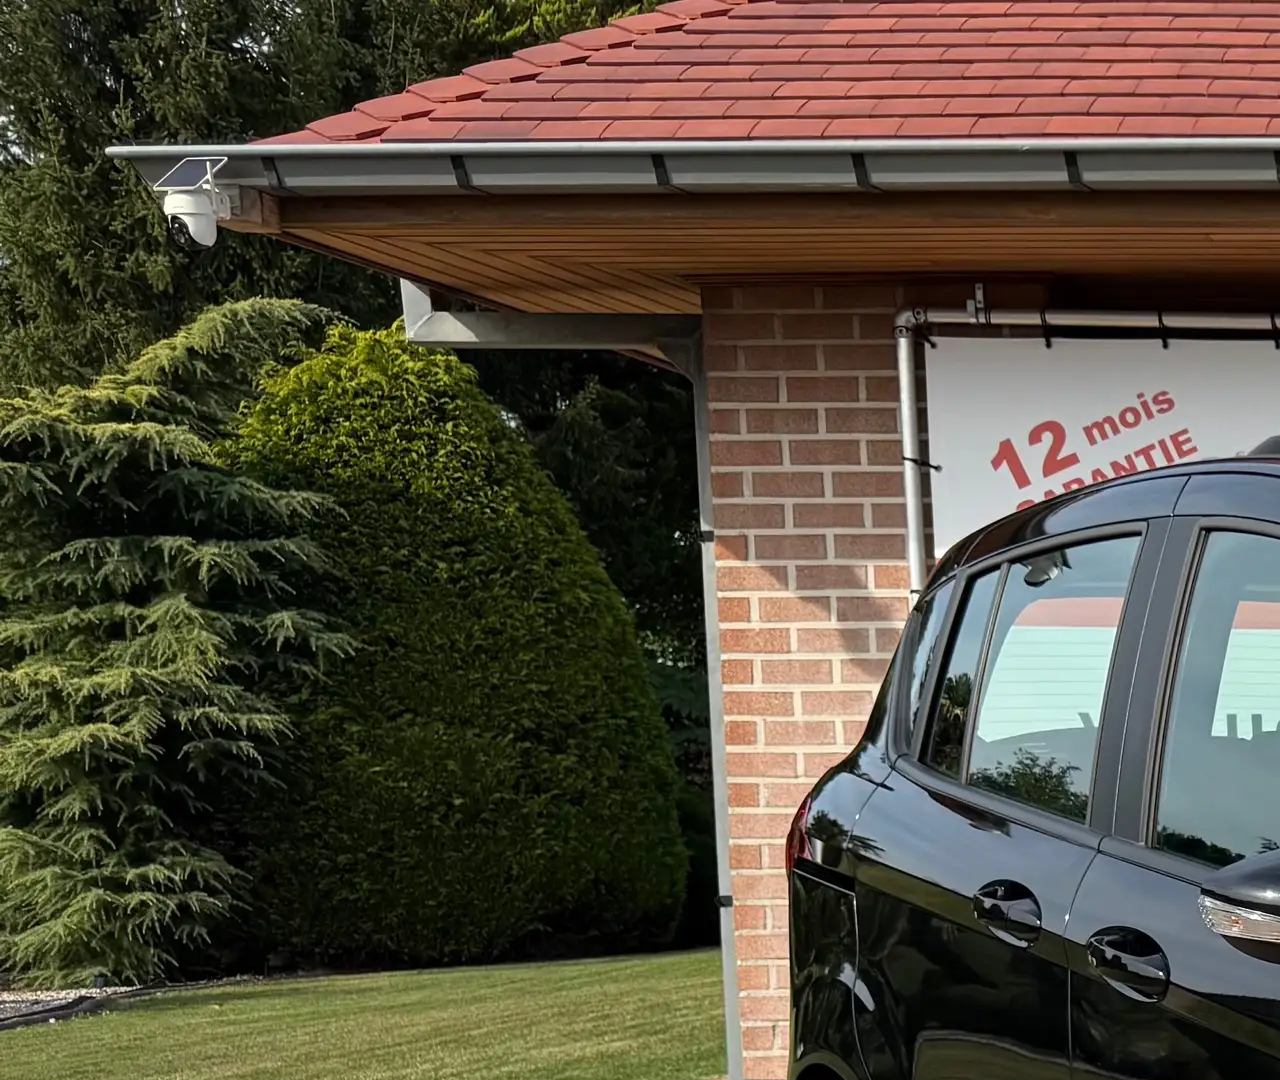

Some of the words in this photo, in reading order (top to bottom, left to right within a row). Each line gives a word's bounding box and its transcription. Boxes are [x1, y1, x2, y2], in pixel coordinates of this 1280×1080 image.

[990, 419, 1081, 490] 12
[1082, 390, 1176, 447] mois
[1015, 427, 1199, 512] NTIE
